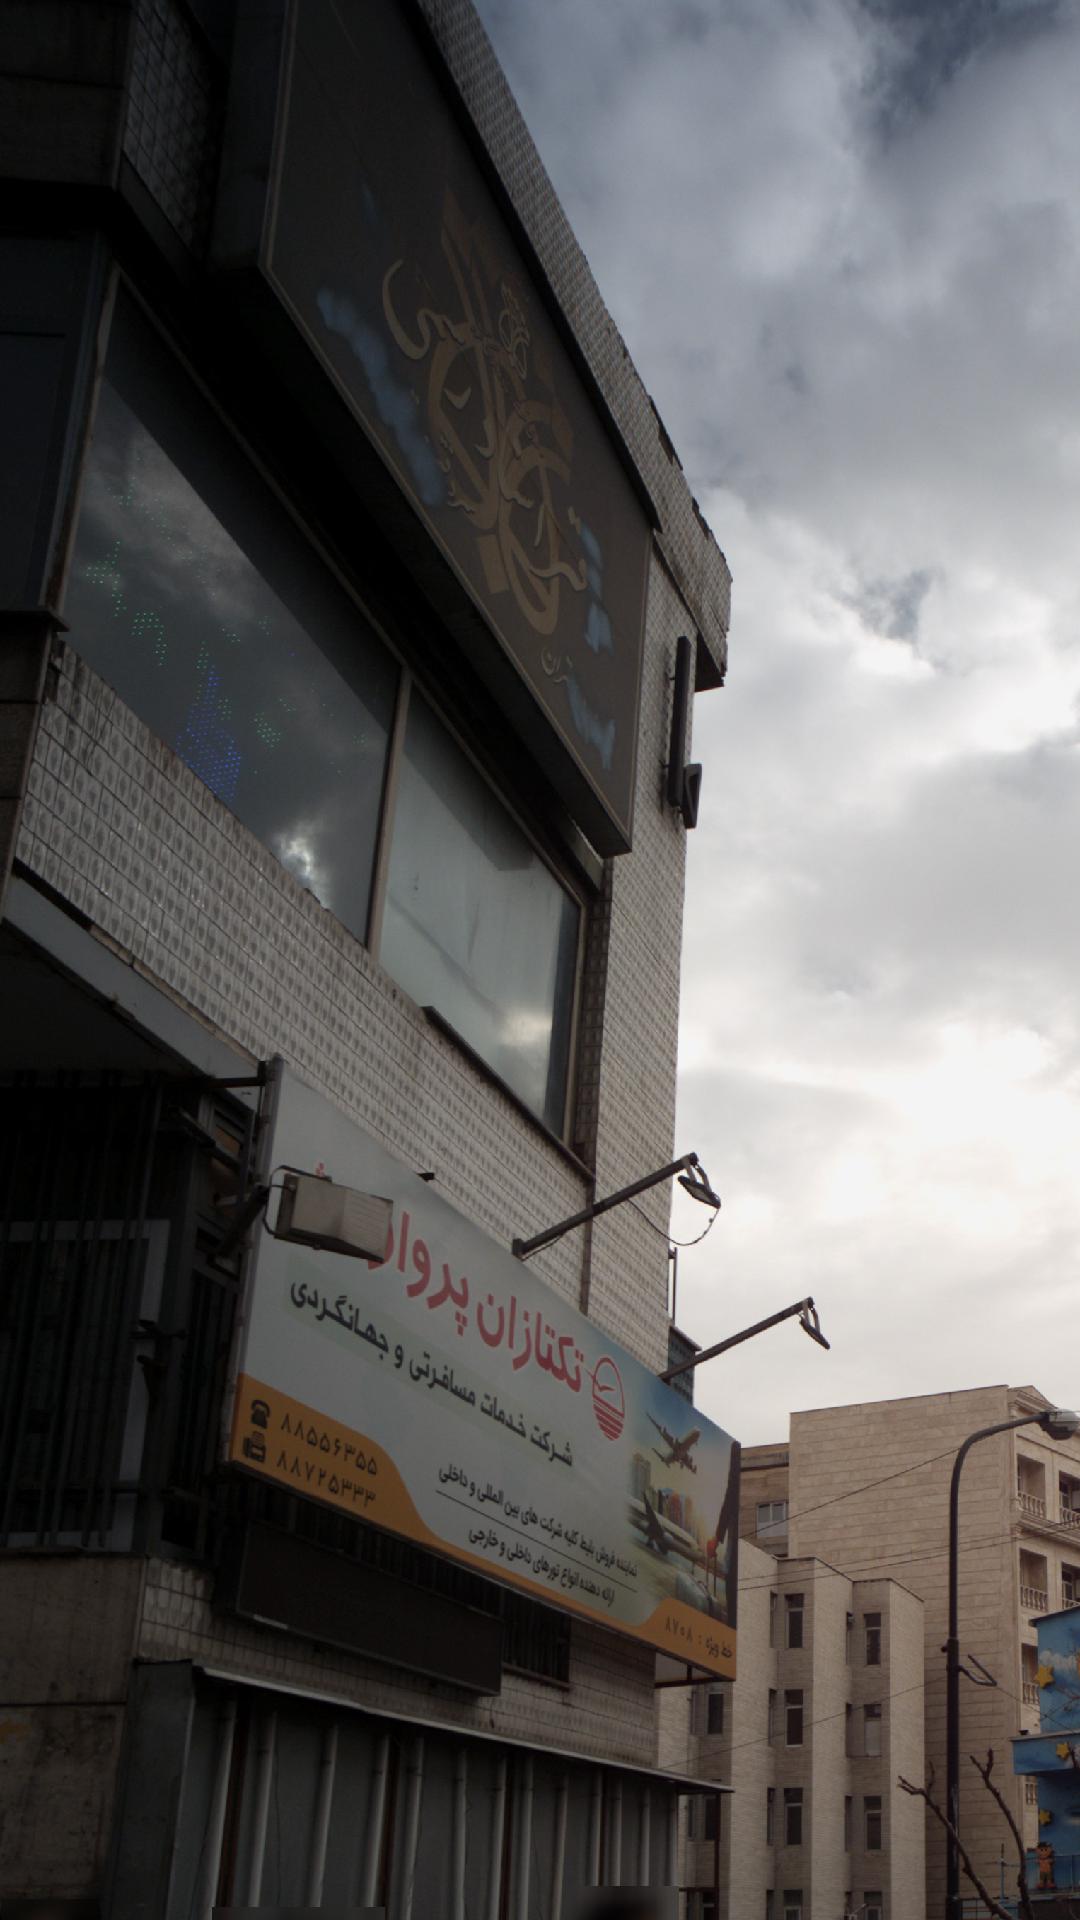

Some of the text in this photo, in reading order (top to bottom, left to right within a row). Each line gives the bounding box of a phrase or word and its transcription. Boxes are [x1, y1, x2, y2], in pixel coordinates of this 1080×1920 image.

[477, 1294, 584, 1392] تکتازان
[290, 1283, 573, 1467] شرکت خدمات مسافرتی و جهانگردی
[281, 1413, 377, 1475] ۸۸۵۵۶۳۵۵
[277, 1451, 376, 1507] ۸۸۷۲۵۳۳۳
[439, 1463, 468, 1488] داخلی
[469, 1481, 476, 1497] و
[477, 1483, 504, 1505] المللی
[504, 1501, 520, 1519] بین
[521, 1507, 538, 1526] های
[468, 1529, 499, 1550] خارجی
[540, 1518, 562, 1539] شرکت
[564, 1529, 579, 1547] کلیه
[499, 1541, 506, 1558] و
[506, 1542, 532, 1565] داخلی
[533, 1555, 560, 1581] تورهای
[560, 1568, 580, 1590] انواع
